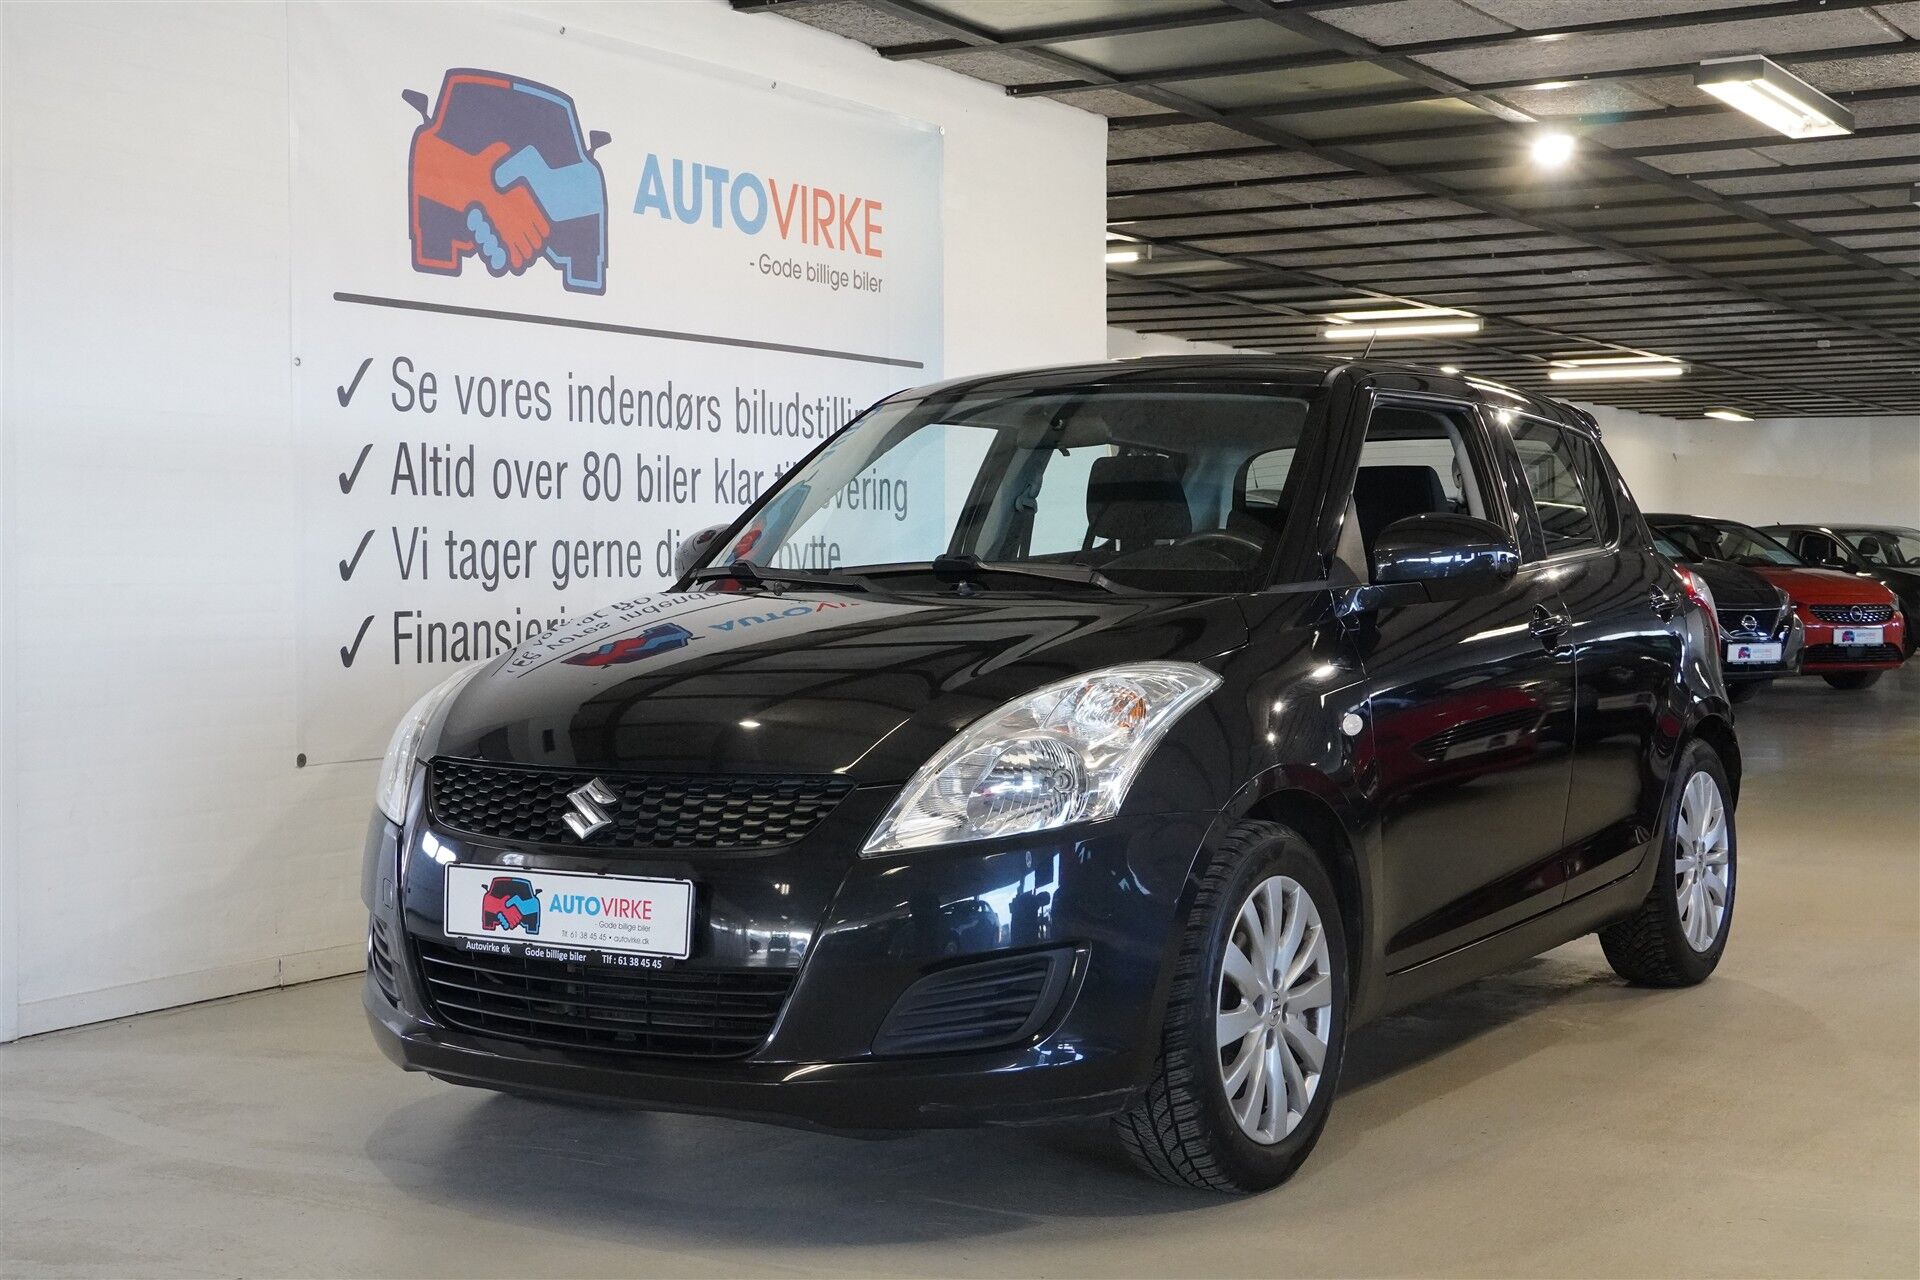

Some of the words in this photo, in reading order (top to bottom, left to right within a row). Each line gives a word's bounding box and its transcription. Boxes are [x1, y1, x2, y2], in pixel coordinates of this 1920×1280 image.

[633, 152, 883, 258] AUTOVIRKE
[759, 253, 802, 280] Gode
[806, 258, 849, 291] billige
[853, 268, 883, 293] biler
[391, 356, 438, 414] Se
[455, 371, 552, 422] vores
[567, 371, 722, 434] indendørs
[391, 440, 476, 500] Altid
[492, 455, 569, 500] over
[582, 450, 622, 503] 80
[636, 453, 702, 505] biler
[714, 457, 767, 506] klar
[391, 525, 428, 582] Vi
[444, 528, 537, 592] tager
[551, 537, 643, 591] gerne
[549, 894, 652, 920] AUTOVIRKE
[579, 931, 588, 940] 38
[589, 932, 597, 940] 45
[598, 932, 607, 941] 45
[598, 920, 617, 930] Gode
[465, 940, 500, 953] Autovirke
[524, 947, 544, 959] Gode
[545, 948, 568, 962] billige
[569, 951, 587, 963] biler
[618, 956, 628, 966] 61
[629, 957, 639, 967] 38
[640, 958, 650, 968] 45
[651, 959, 662, 970] 45
